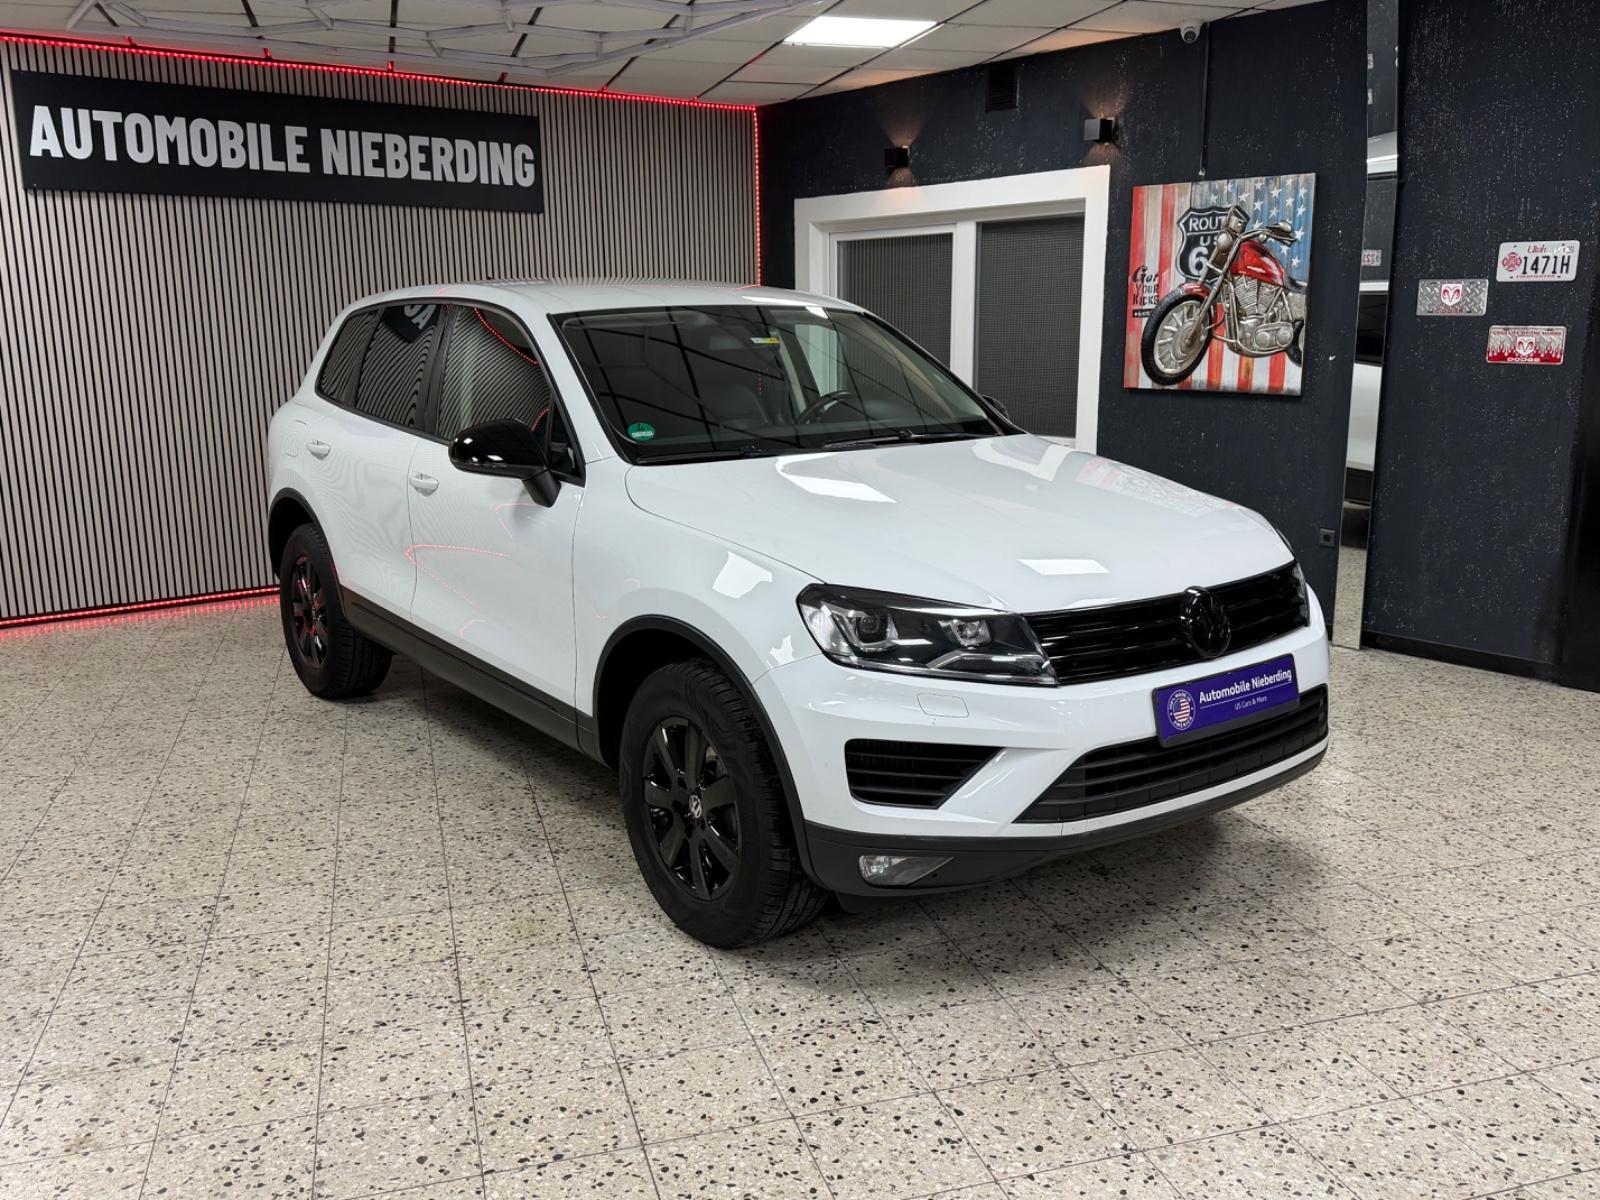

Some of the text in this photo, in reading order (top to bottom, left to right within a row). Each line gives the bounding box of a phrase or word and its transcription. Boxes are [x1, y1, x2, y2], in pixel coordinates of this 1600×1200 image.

[29, 104, 536, 188] AUTOMOBILE NIEBERDING
[1189, 215, 1228, 231] ROUT
[1189, 246, 1208, 276] 6
[1521, 255, 1571, 275] 1471H
[1199, 669, 1292, 703] Automobile Nieberding
